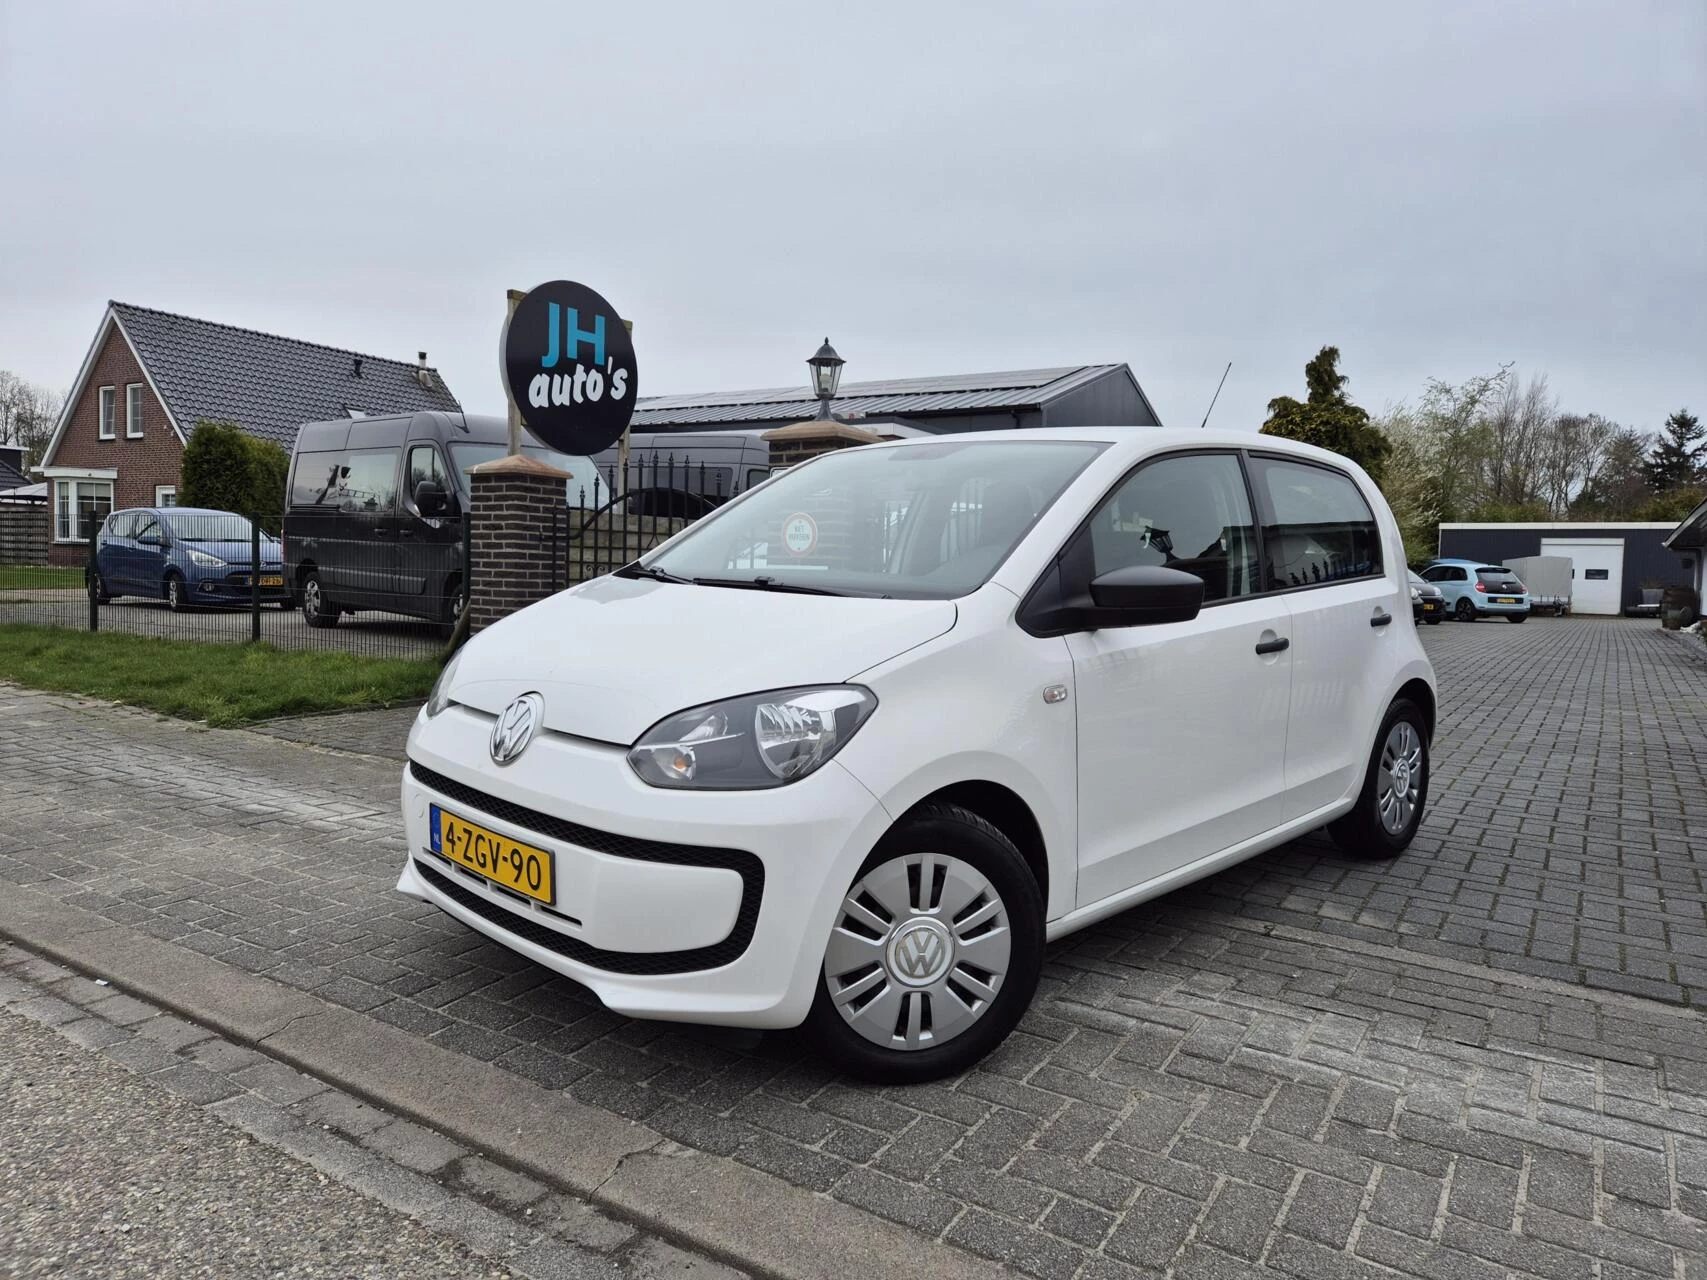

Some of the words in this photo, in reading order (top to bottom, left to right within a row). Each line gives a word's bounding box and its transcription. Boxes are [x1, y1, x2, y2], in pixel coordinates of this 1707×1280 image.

[541, 302, 606, 368] JH
[528, 356, 628, 408] auto's
[445, 821, 541, 891] 4-ZGV-90
[894, 925, 947, 980] VW
